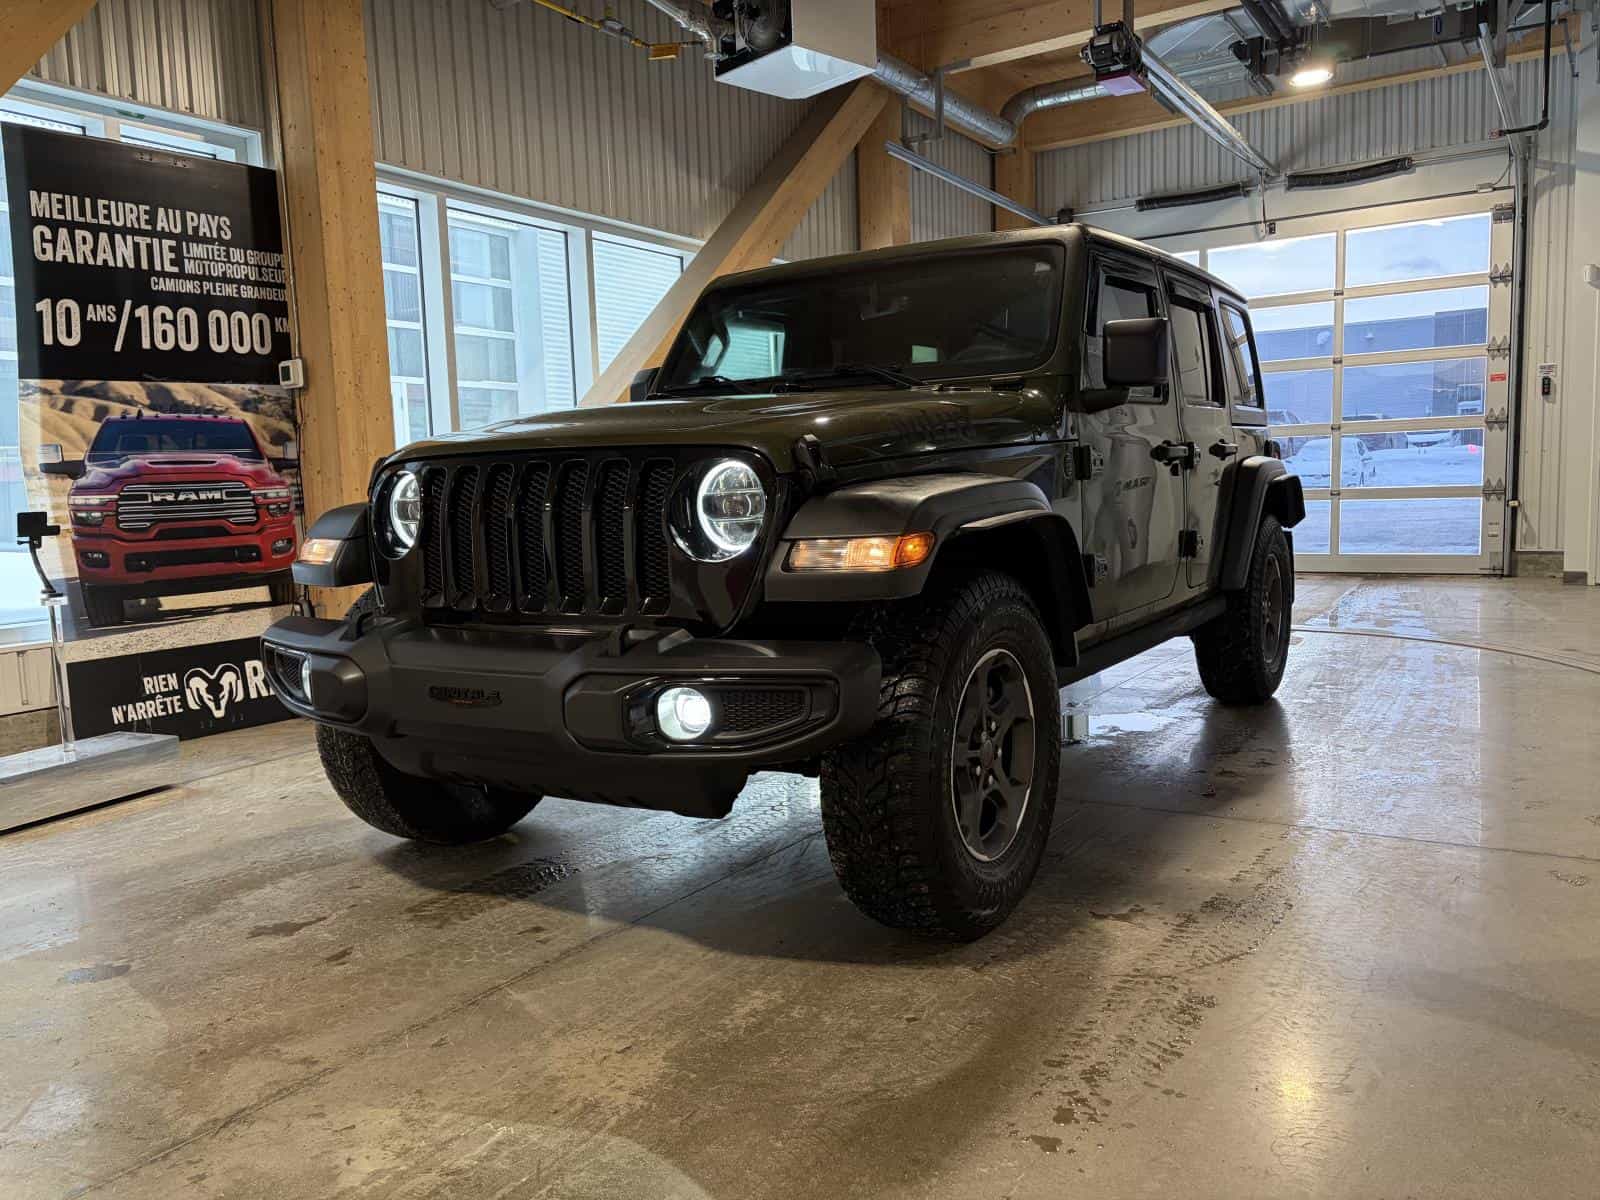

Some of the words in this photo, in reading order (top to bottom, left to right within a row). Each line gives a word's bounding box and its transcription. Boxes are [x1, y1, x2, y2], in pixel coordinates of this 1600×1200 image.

[29, 189, 152, 230] MEILLEURE
[154, 207, 181, 234] AU
[186, 211, 232, 240] PAYS
[32, 225, 179, 273] GARANTIE
[182, 241, 228, 261] LIMITÉE
[229, 247, 245, 263] DU
[150, 276, 201, 294] CAMIONS
[202, 281, 239, 298] PLEINE
[35, 298, 81, 347] 10
[208, 309, 272, 355] 000
[152, 490, 222, 501] RAM
[143, 672, 179, 695] RIEN
[111, 694, 184, 725] N'ARRÊTE
